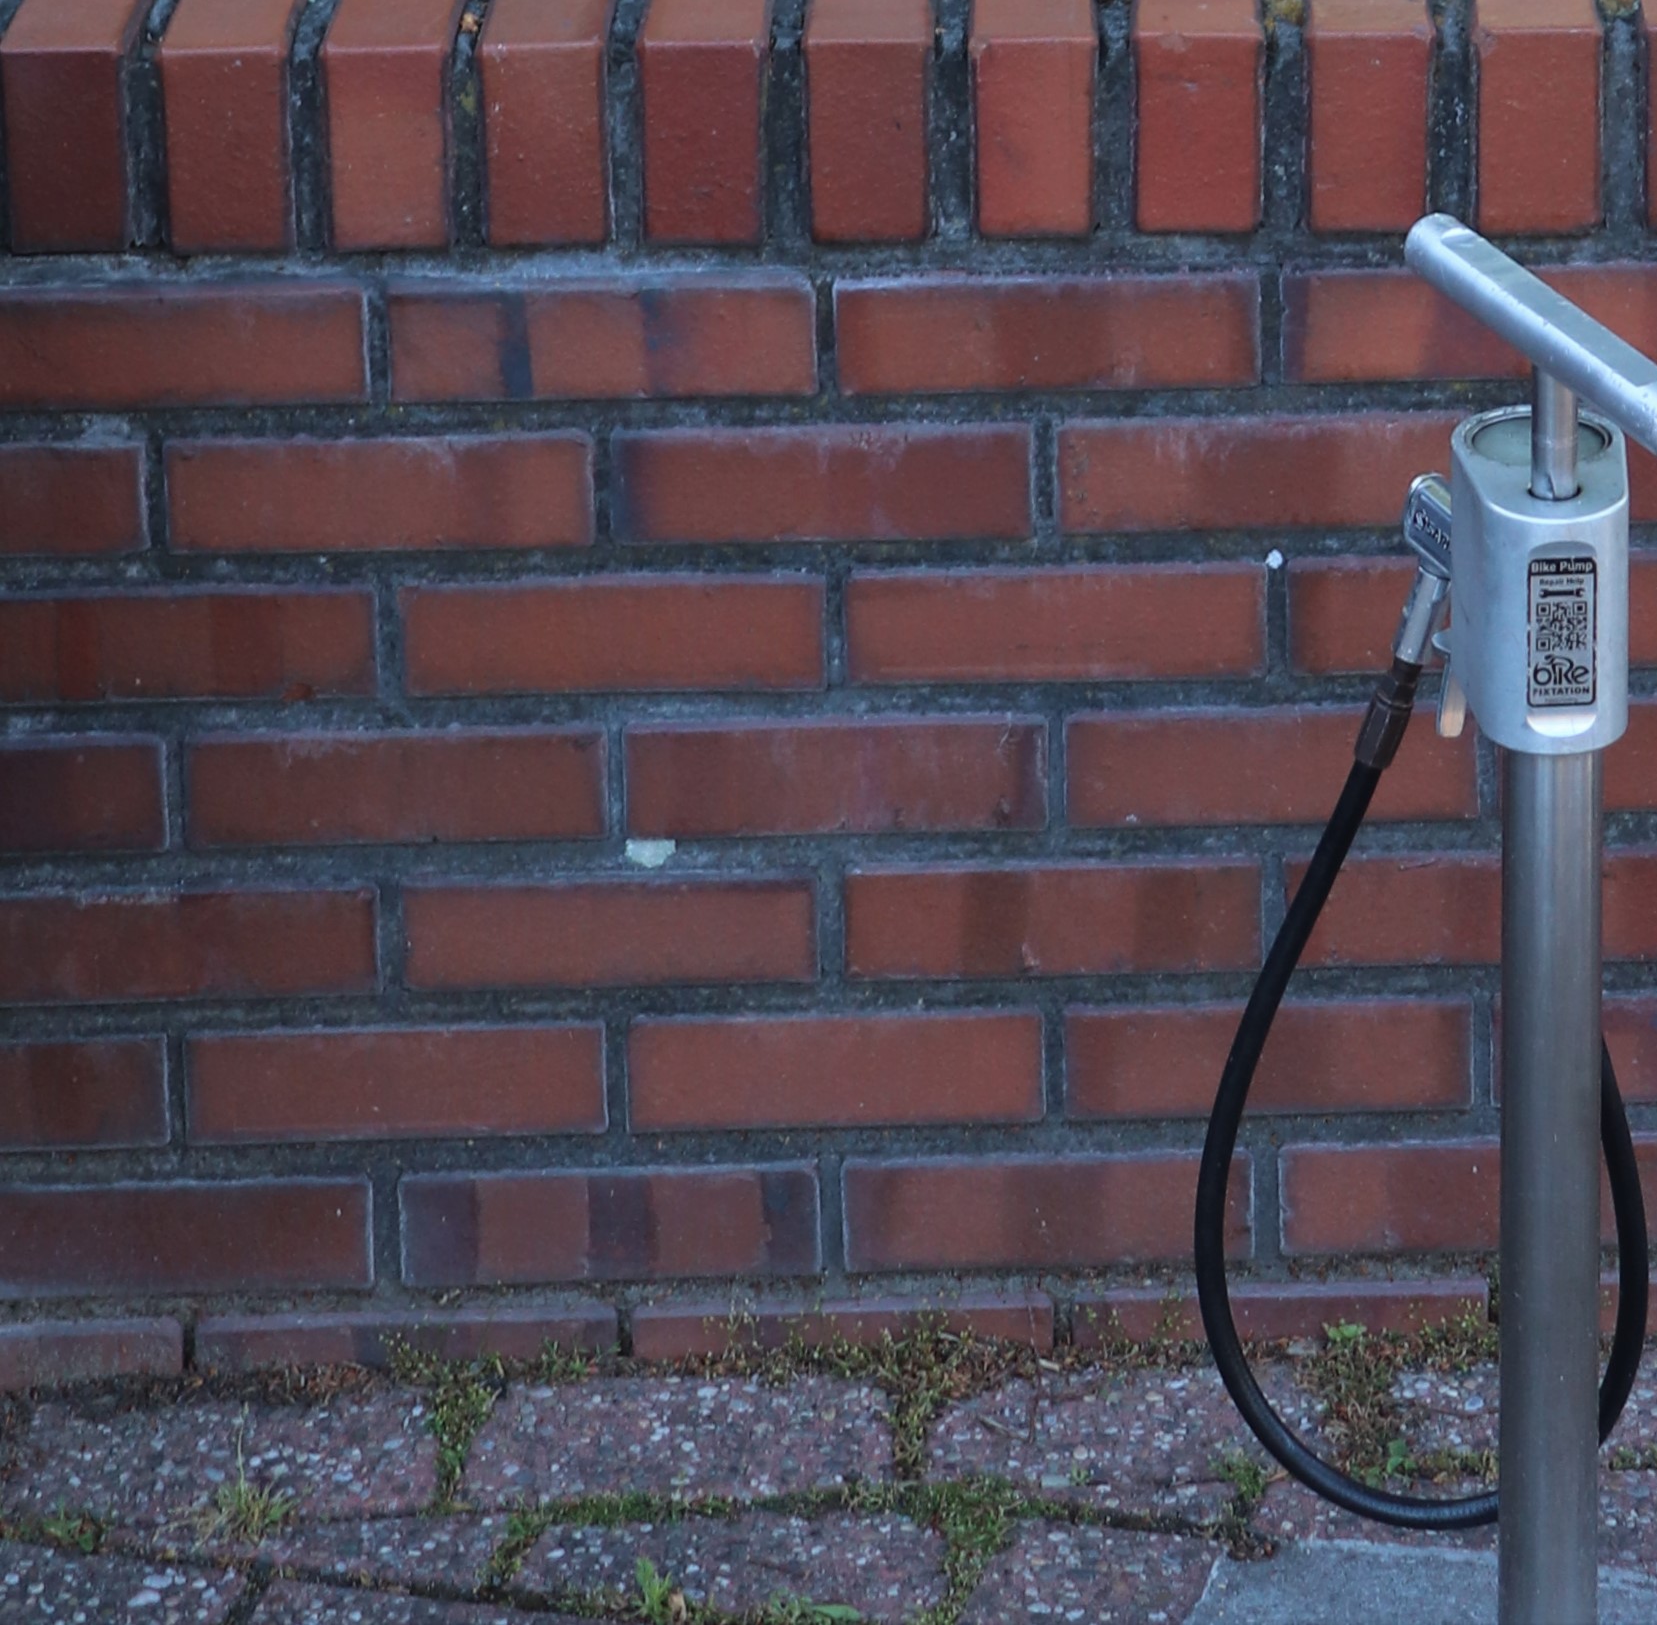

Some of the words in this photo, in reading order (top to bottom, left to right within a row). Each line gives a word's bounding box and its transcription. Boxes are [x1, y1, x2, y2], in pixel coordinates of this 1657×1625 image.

[1531, 561, 1557, 573] Bike
[1560, 560, 1593, 573] Pump
[1539, 578, 1565, 587] Repair
[1566, 577, 1585, 586] Help
